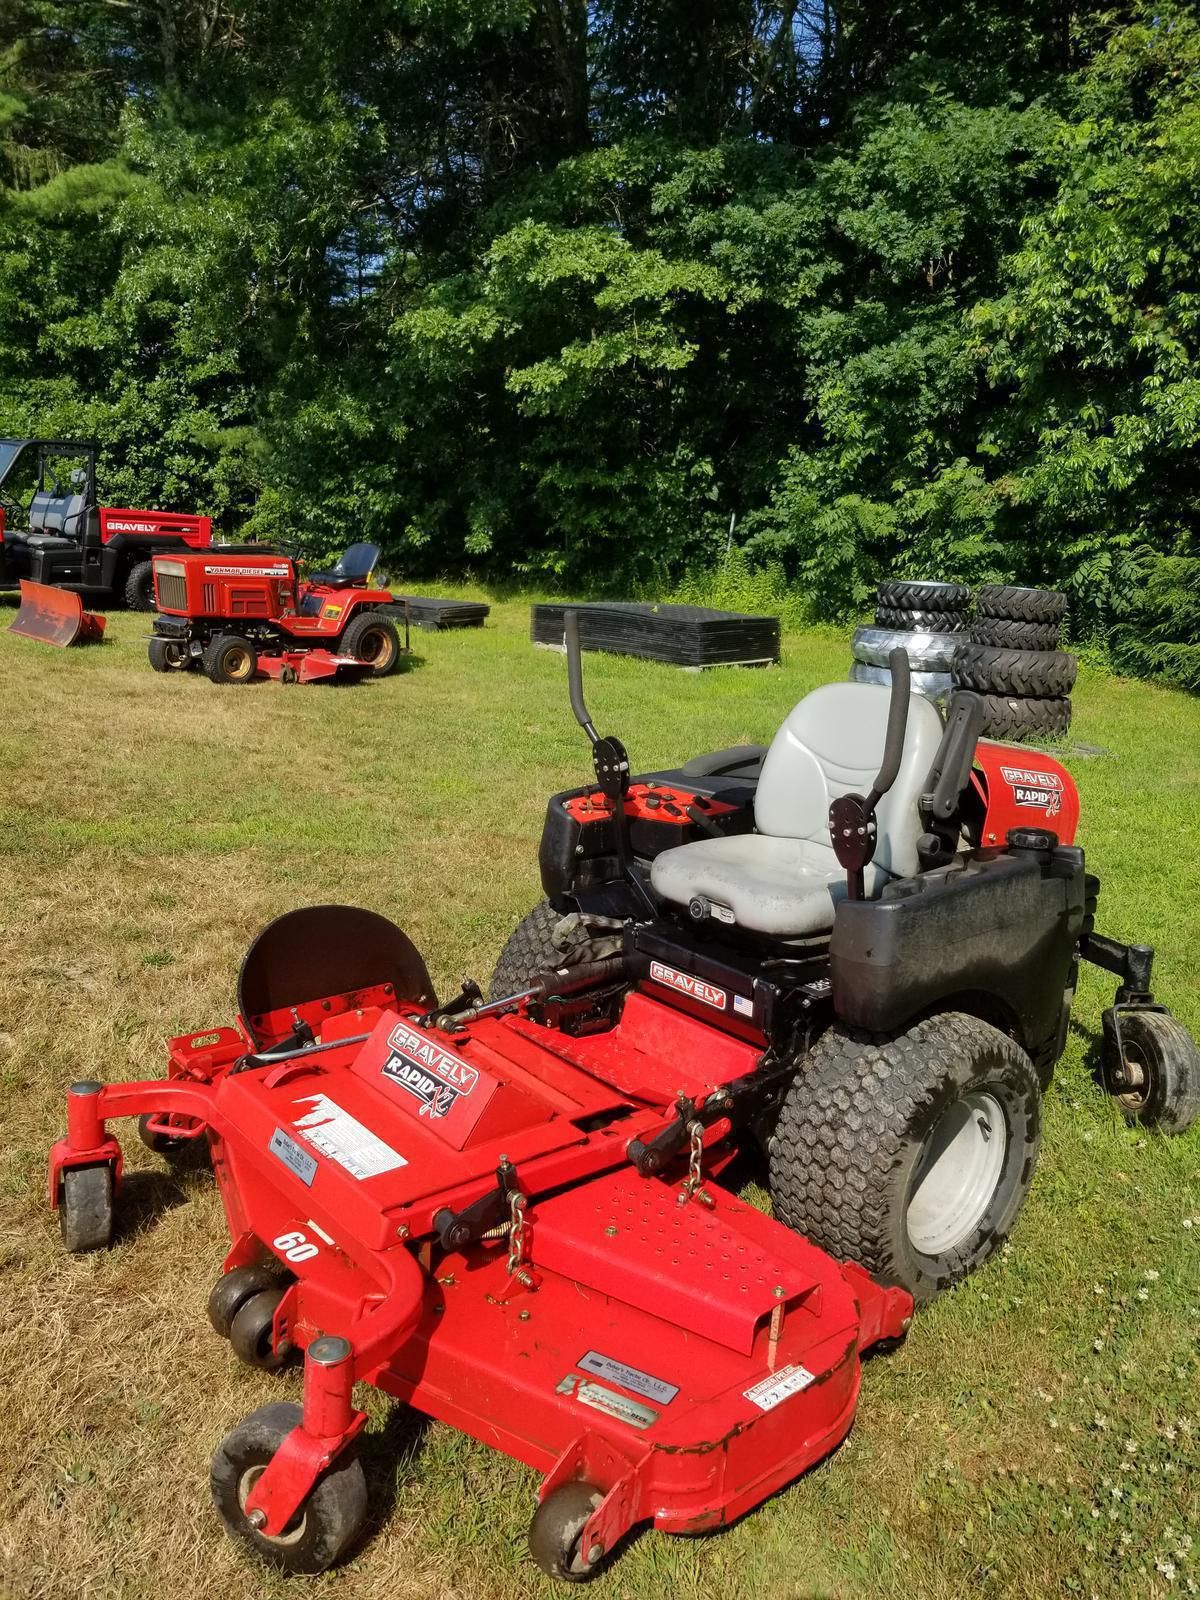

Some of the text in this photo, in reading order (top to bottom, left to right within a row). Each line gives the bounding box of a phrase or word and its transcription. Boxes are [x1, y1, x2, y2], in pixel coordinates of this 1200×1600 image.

[106, 522, 157, 532] GRAVELY
[210, 567, 240, 575] YANMAR
[241, 568, 265, 576] DIESEL
[1003, 769, 1059, 788] GRAVELY
[1016, 789, 1048, 803] RAPID
[652, 965, 723, 1003] GRAVELY
[393, 1028, 474, 1087] GRAVELY
[387, 1056, 435, 1093] RAPID
[273, 1231, 319, 1262] 60
